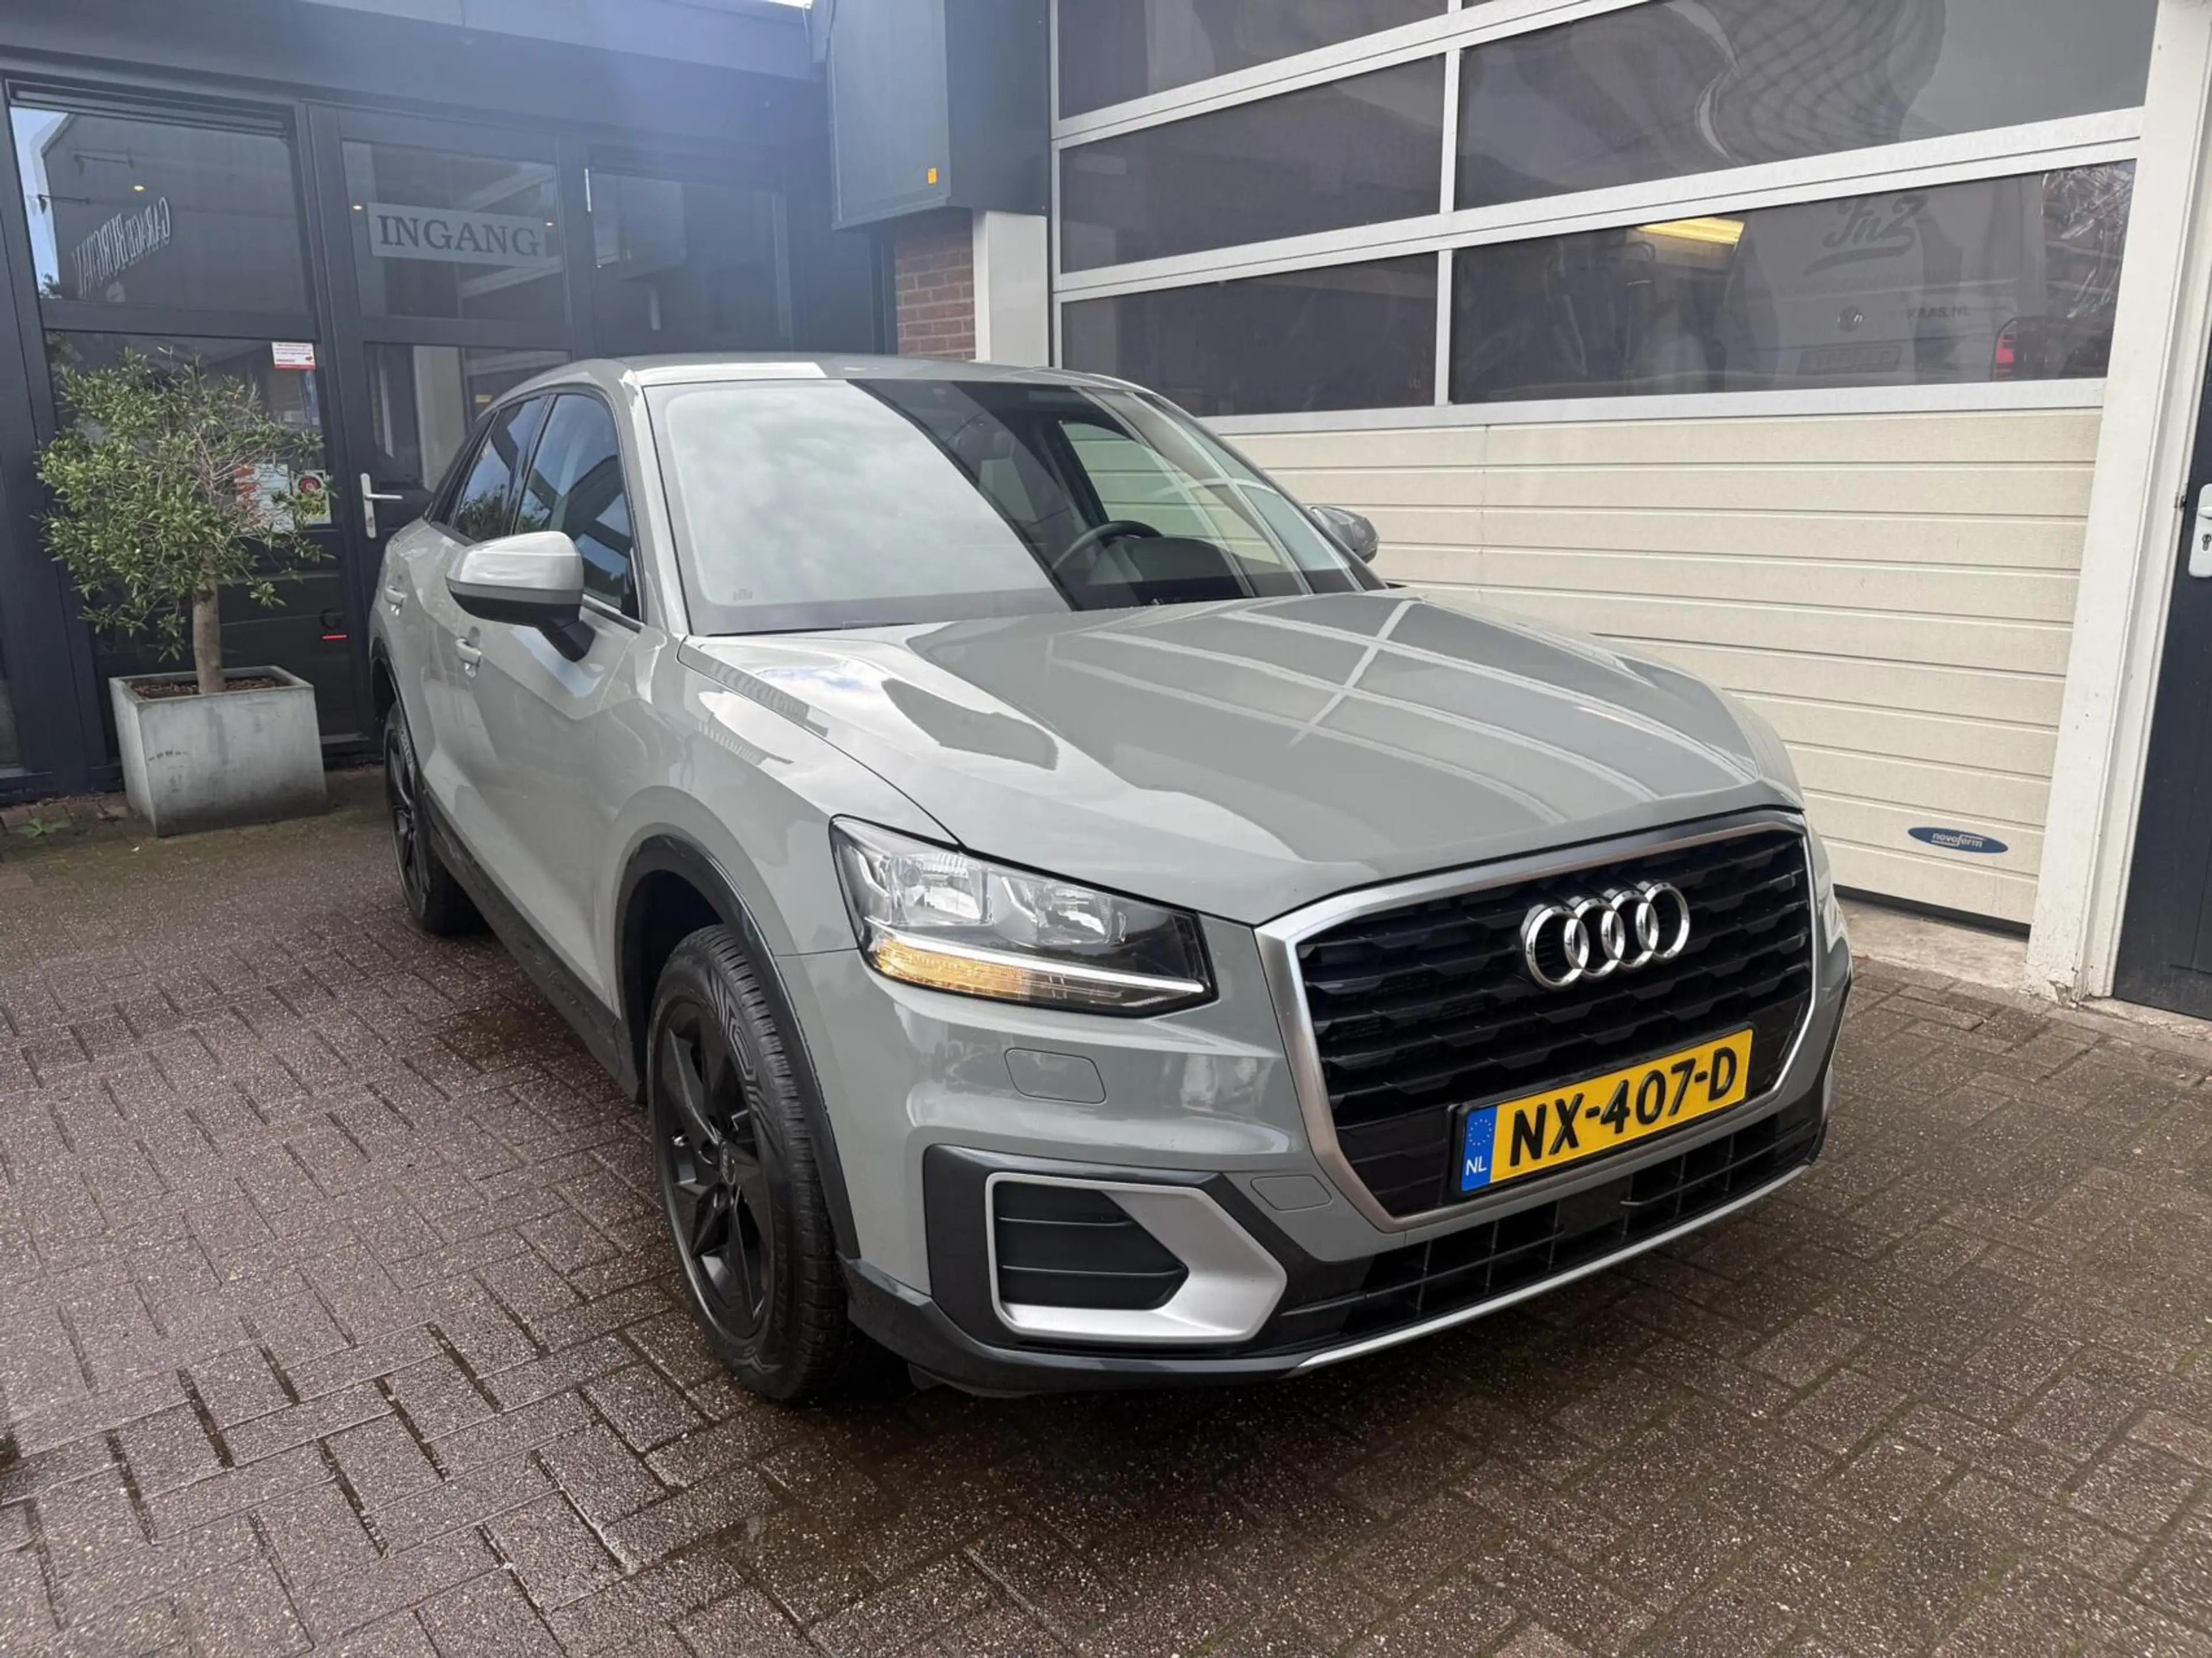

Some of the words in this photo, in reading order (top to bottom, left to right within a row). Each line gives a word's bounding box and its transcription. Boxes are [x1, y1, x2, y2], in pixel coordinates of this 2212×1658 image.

[377, 215, 540, 257] INGANG
[1931, 833, 1983, 848] novoferm
[1509, 1046, 1737, 1167] NX-407-D
[1465, 1155, 1487, 1176] NL
